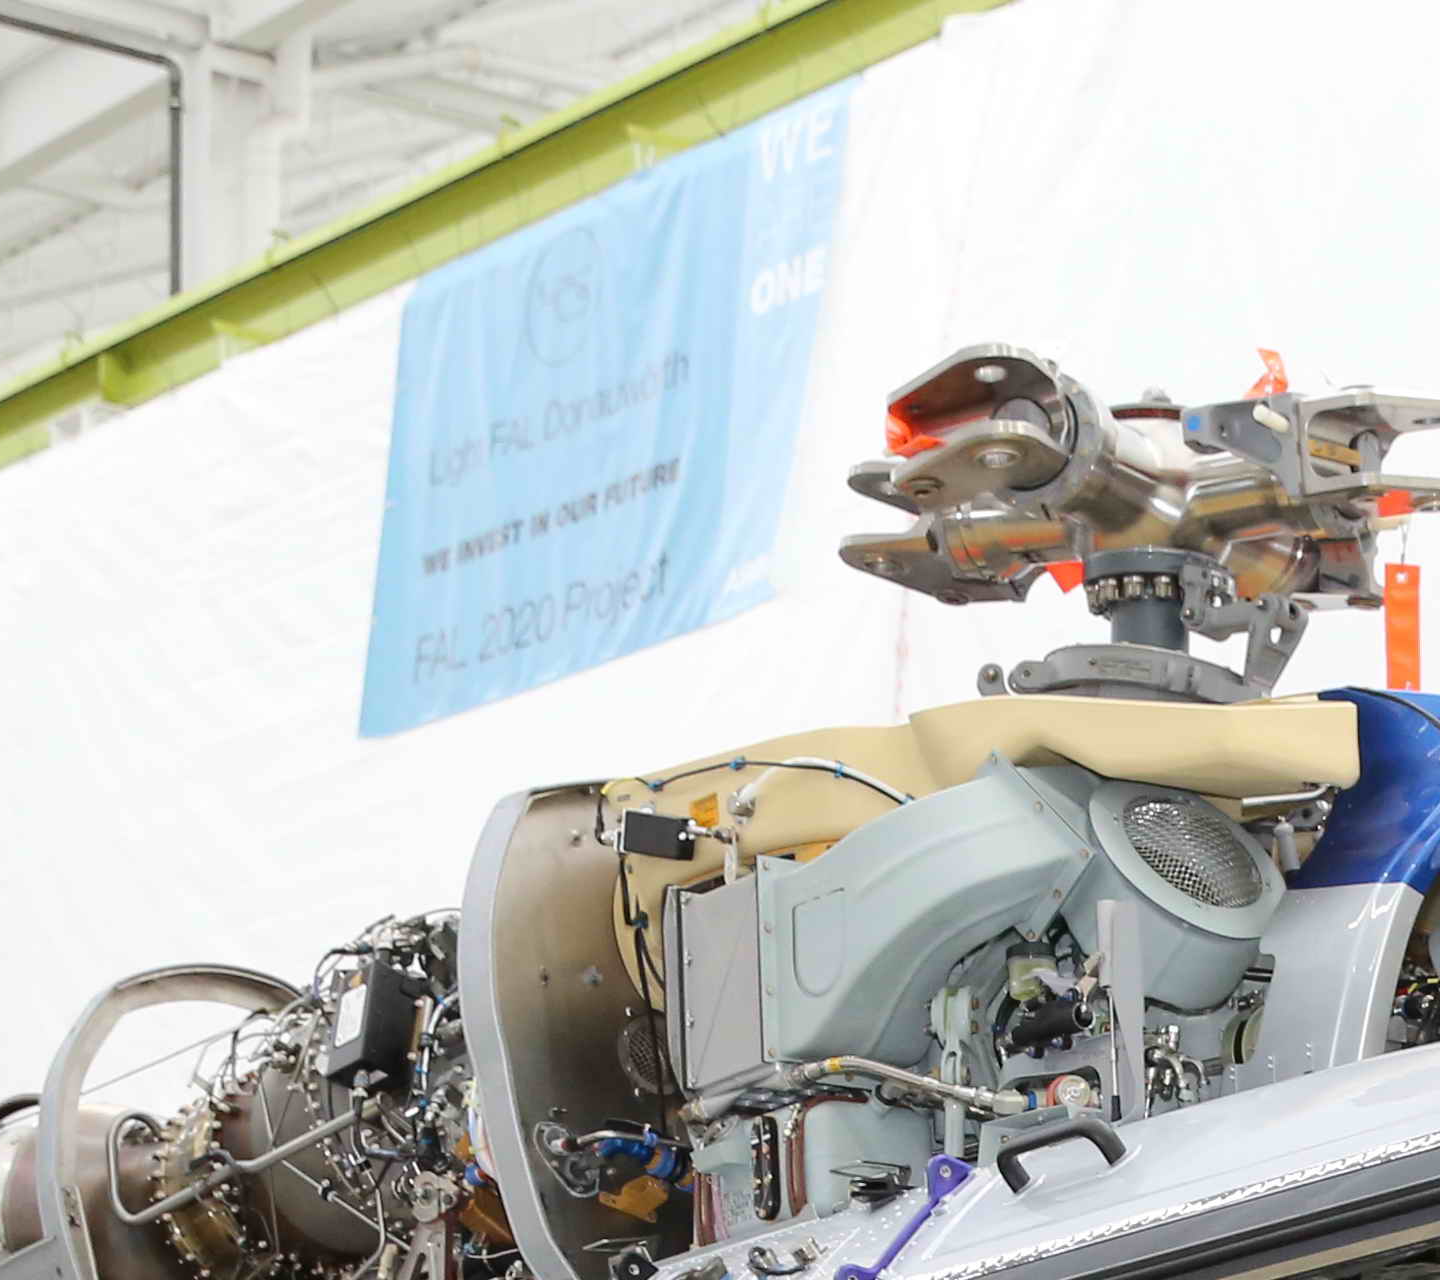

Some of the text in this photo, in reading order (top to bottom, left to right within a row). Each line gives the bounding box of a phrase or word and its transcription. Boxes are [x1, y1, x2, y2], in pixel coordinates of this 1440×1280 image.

[760, 111, 833, 181] WE
[751, 245, 827, 316] ONE
[488, 417, 534, 456] FAL
[421, 457, 680, 576] WE INVEST IN OUR FUTURE
[412, 622, 467, 685] FAL
[478, 591, 555, 664] 2020
